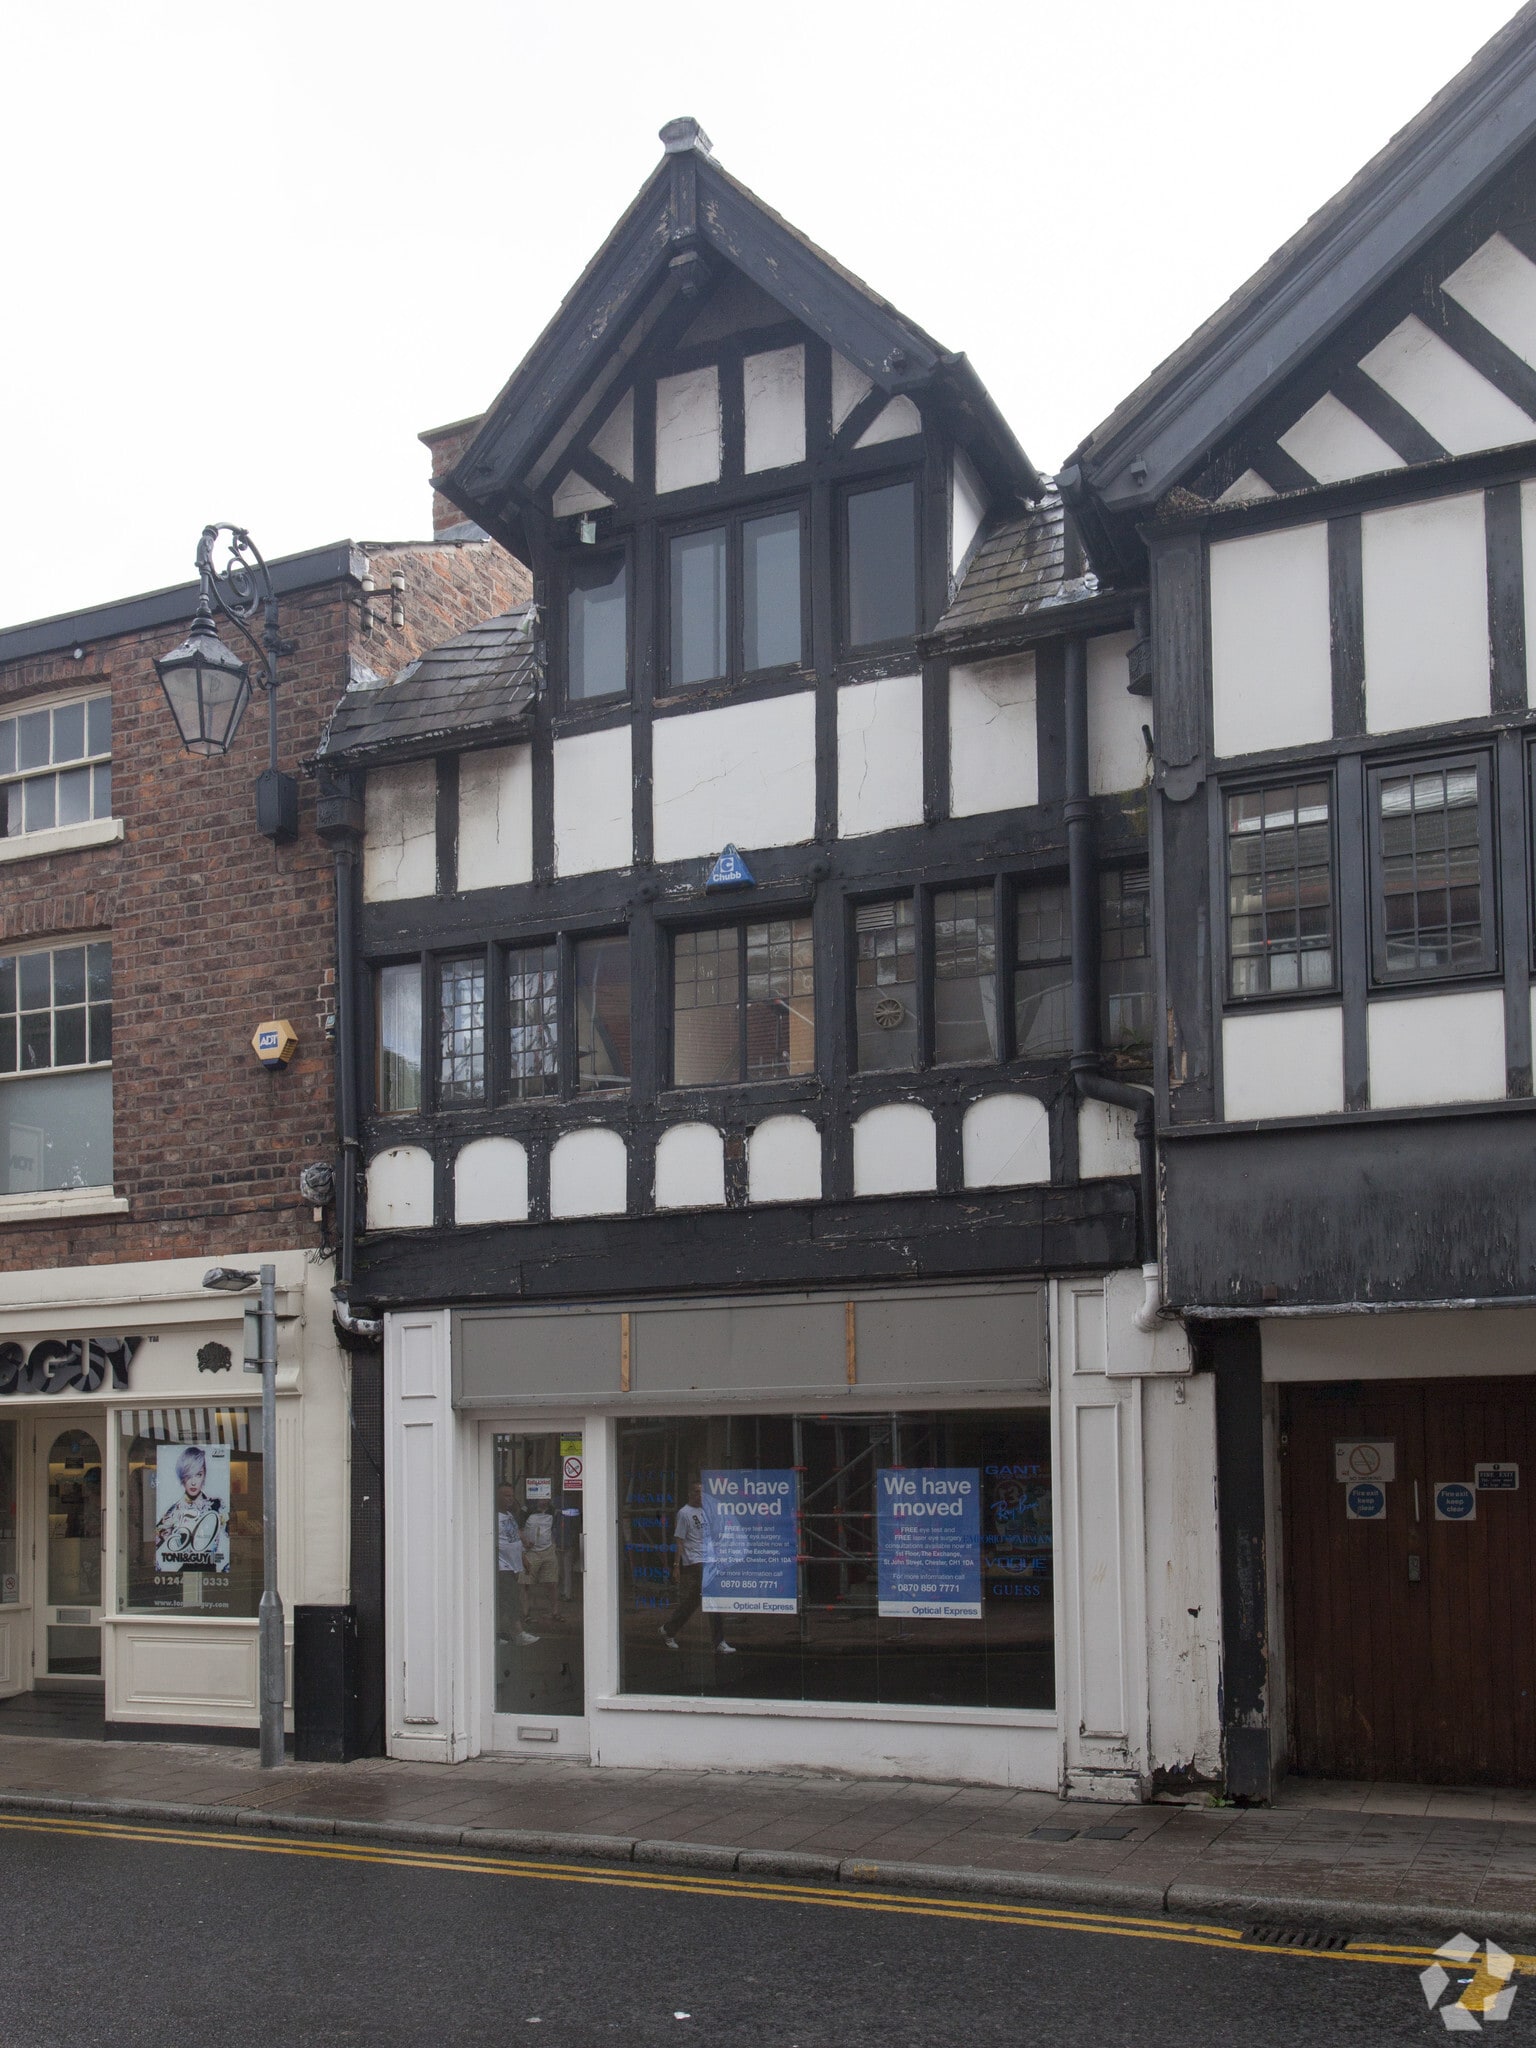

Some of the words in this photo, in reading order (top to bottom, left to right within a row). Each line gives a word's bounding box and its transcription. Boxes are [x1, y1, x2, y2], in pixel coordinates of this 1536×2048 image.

[712, 871, 742, 882] Chubb
[259, 1034, 278, 1047] ADT
[984, 1465, 1040, 1475] GANT
[708, 1477, 739, 1495] We
[743, 1477, 790, 1495] have
[883, 1477, 917, 1495] We
[922, 1476, 972, 1495] have
[717, 1498, 782, 1516] moved
[893, 1497, 963, 1516] moved
[741, 1526, 752, 1534] eye
[919, 1527, 930, 1535] eye
[927, 1535, 939, 1543] eye
[939, 1535, 963, 1543] surgery
[625, 1543, 678, 1553] POLICE
[161, 1552, 209, 1563] TONI&GUY
[746, 1556, 767, 1564] Chester,
[904, 1550, 920, 1558] Floor,
[932, 1550, 962, 1559] Exchange,
[905, 1559, 923, 1567] Street,
[924, 1559, 948, 1567] Chester,
[985, 1557, 1047, 1570] VOGUE
[720, 1580, 741, 1588] 0870
[741, 1580, 757, 1589] 850
[759, 1580, 778, 1589] 7771
[897, 1583, 919, 1592] 0870
[920, 1584, 937, 1592] 850
[939, 1584, 960, 1593] 7771
[993, 1584, 1040, 1597] GUESS
[733, 1601, 760, 1611] Optical
[762, 1602, 794, 1612] Express
[911, 1605, 942, 1615] Optical
[943, 1606, 978, 1616] Express
